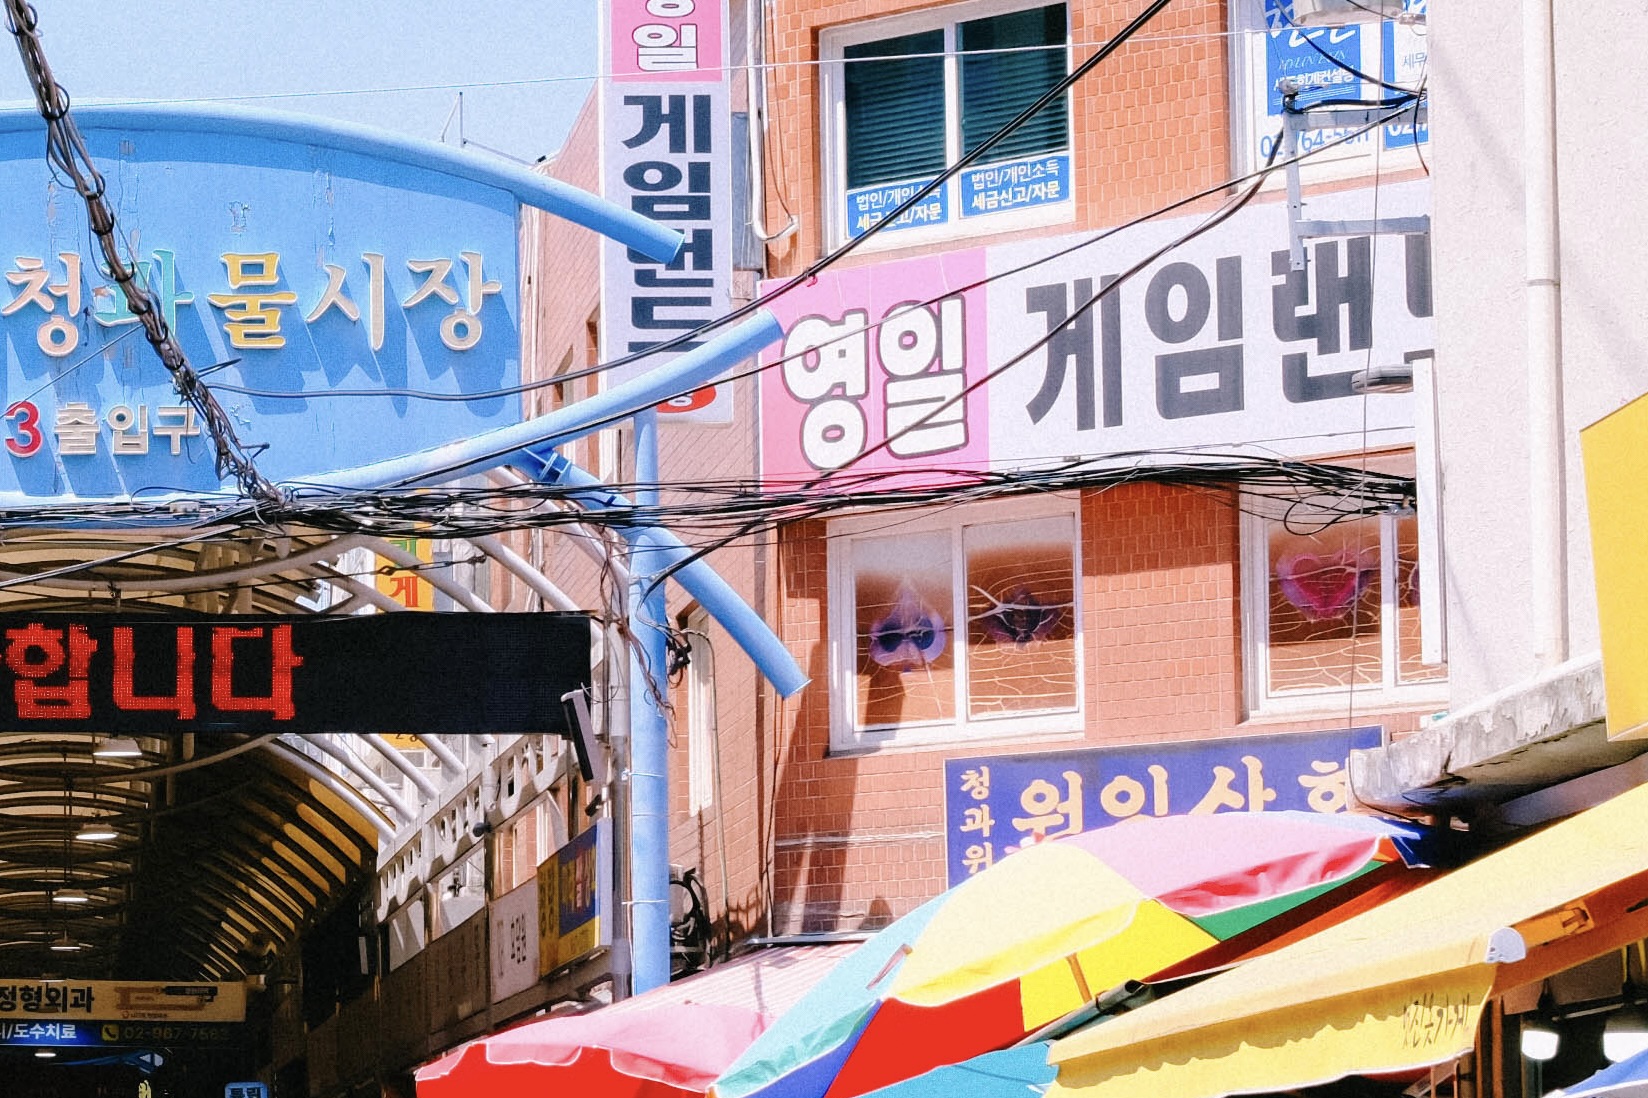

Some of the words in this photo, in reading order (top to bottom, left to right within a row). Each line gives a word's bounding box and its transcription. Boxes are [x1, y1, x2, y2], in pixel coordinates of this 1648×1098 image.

[971, 159, 1060, 191] 법인/개인소득
[971, 181, 1062, 212] 세금신고/자문
[780, 294, 970, 471] 영일
[4, 399, 43, 458] 3
[54, 401, 201, 456] 출입구
